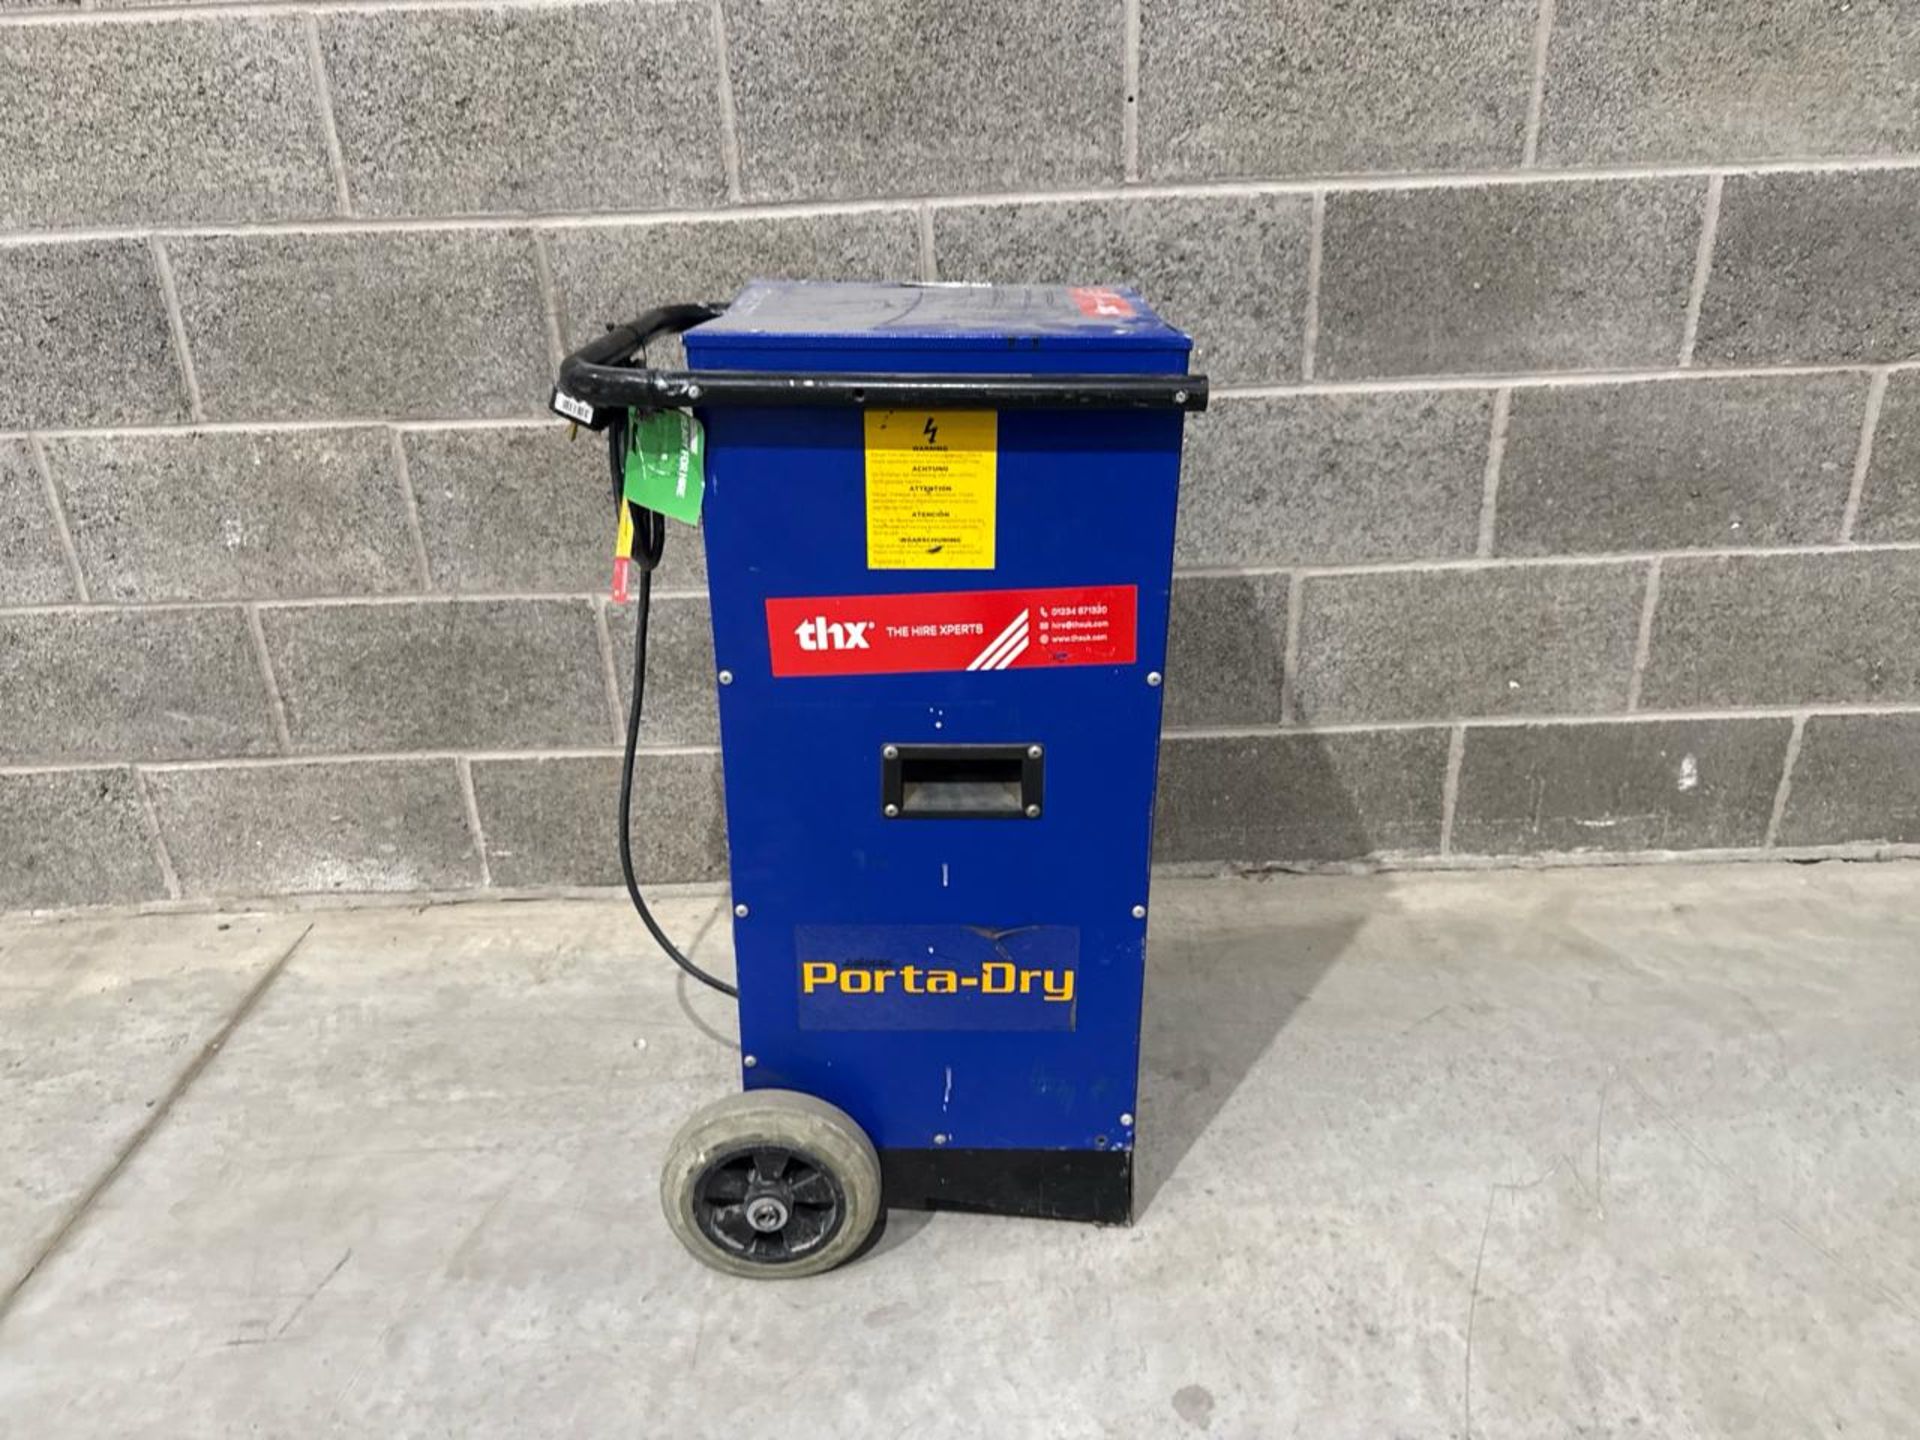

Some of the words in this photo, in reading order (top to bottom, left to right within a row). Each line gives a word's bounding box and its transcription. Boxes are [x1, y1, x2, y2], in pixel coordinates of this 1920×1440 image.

[678, 450, 690, 472] FOR
[675, 472, 688, 499] HIRE
[1051, 606, 1076, 616] 01234
[886, 625, 908, 638] THE
[911, 624, 937, 637] HIRE
[939, 623, 984, 636] XPERTS
[802, 961, 1075, 1001] Porta-Dry
